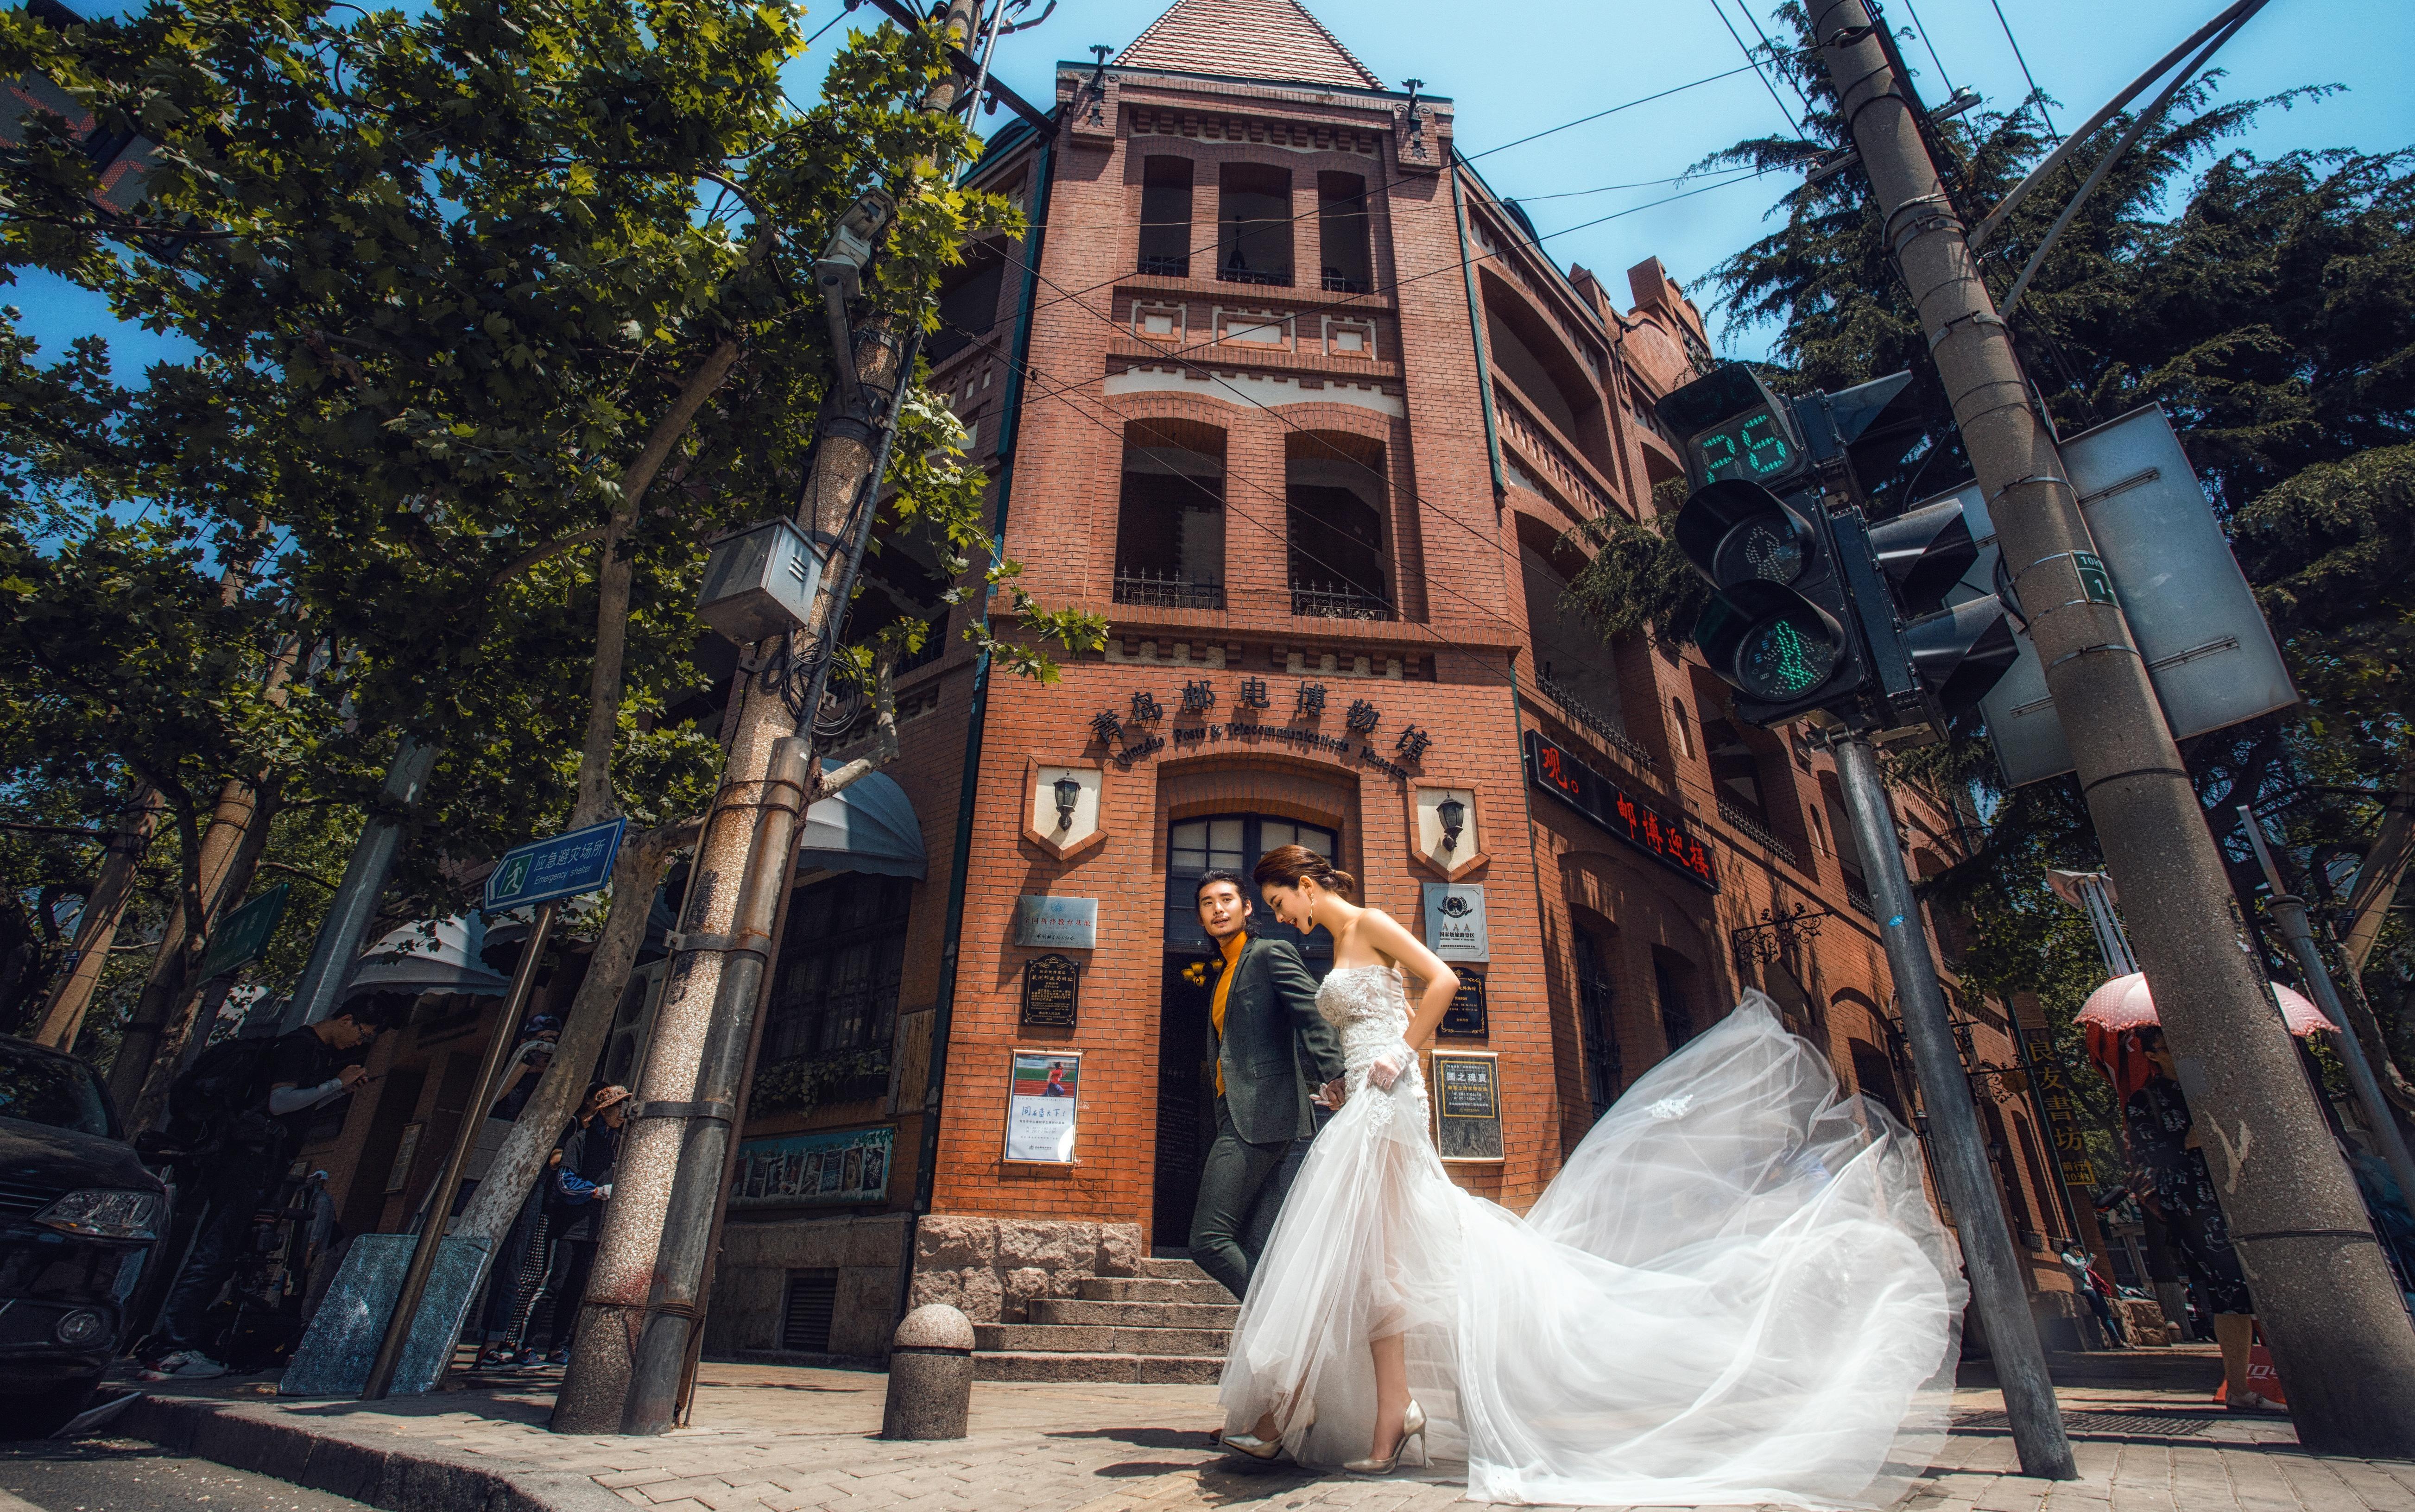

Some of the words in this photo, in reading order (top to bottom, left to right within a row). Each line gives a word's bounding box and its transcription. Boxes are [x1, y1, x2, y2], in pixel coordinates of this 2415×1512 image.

[1702, 415, 1786, 484] 26
[1089, 676, 1432, 762] 青岛邮电博物馆
[1117, 736, 1164, 765] Qingdao
[1173, 728, 1205, 743] Posts
[1211, 724, 1221, 737] &
[1228, 723, 1349, 752] Telecommunications
[1359, 746, 1408, 780] Museum
[1617, 792, 1717, 881] 邮博迎接
[534, 839, 606, 872] 应急避灾场所
[534, 871, 568, 885] Emergency
[570, 864, 592, 876] shelter
[1024, 917, 1091, 926] 全国科普教育基地
[1447, 1072, 1486, 1082] 國之瑰寶
[2029, 1038, 2083, 1152] 良友書坊
[2061, 1161, 2085, 1172] 前行
[2065, 1172, 2090, 1182] 10米
